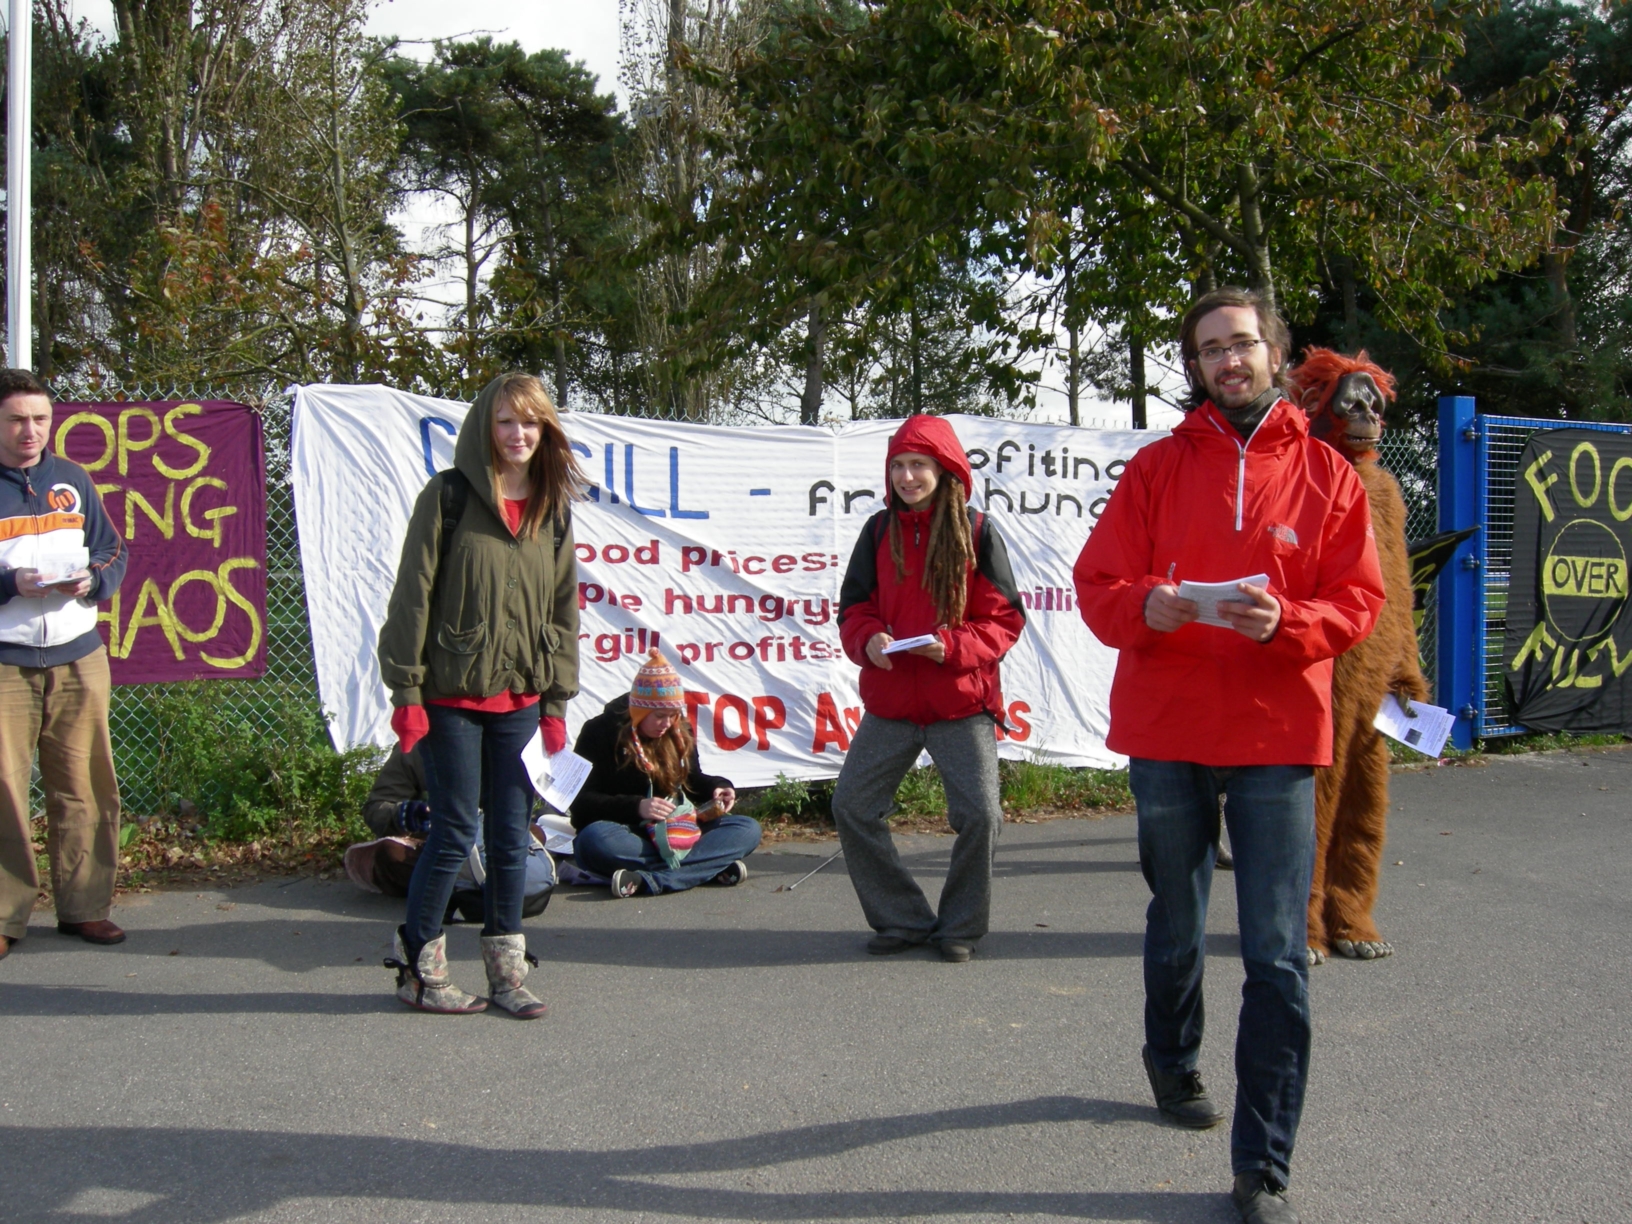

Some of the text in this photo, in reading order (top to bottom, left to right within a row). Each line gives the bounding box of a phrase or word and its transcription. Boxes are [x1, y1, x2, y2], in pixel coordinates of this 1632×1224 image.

[681, 545, 838, 576] prices:
[1552, 557, 1621, 594] OVER
[676, 635, 842, 666] profits:
